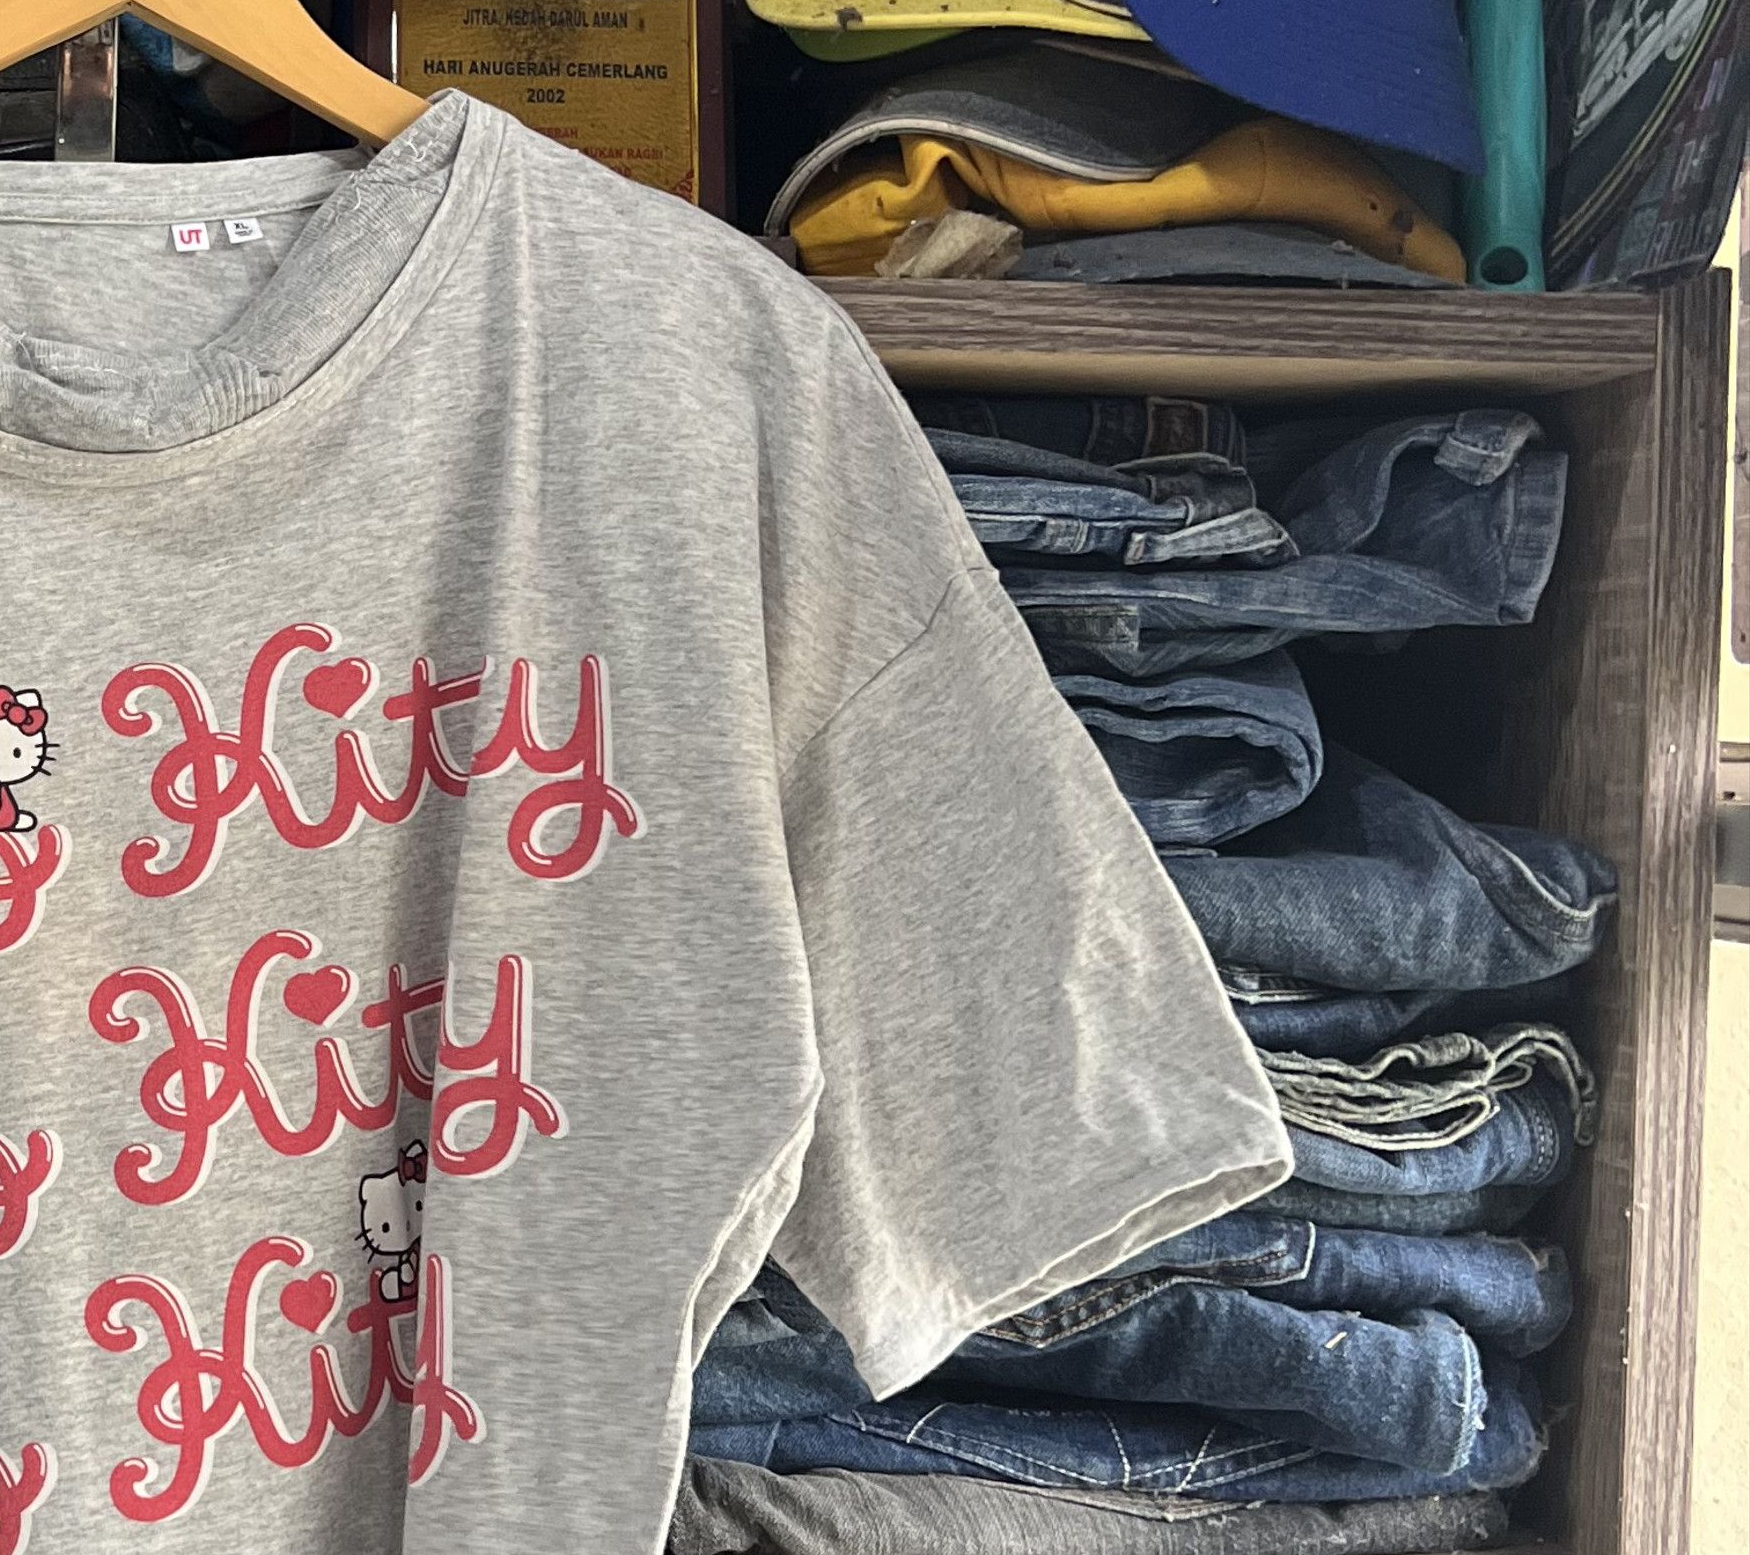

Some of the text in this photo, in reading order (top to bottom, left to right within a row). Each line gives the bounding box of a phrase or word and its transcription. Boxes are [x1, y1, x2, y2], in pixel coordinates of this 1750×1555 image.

[549, 10, 589, 28] DARUL
[592, 11, 628, 29] AMAN
[423, 59, 668, 80] HARI ANUGERAH CEMERLANG
[526, 88, 566, 104] 2002
[234, 222, 249, 230] XL
[179, 229, 202, 245] UT
